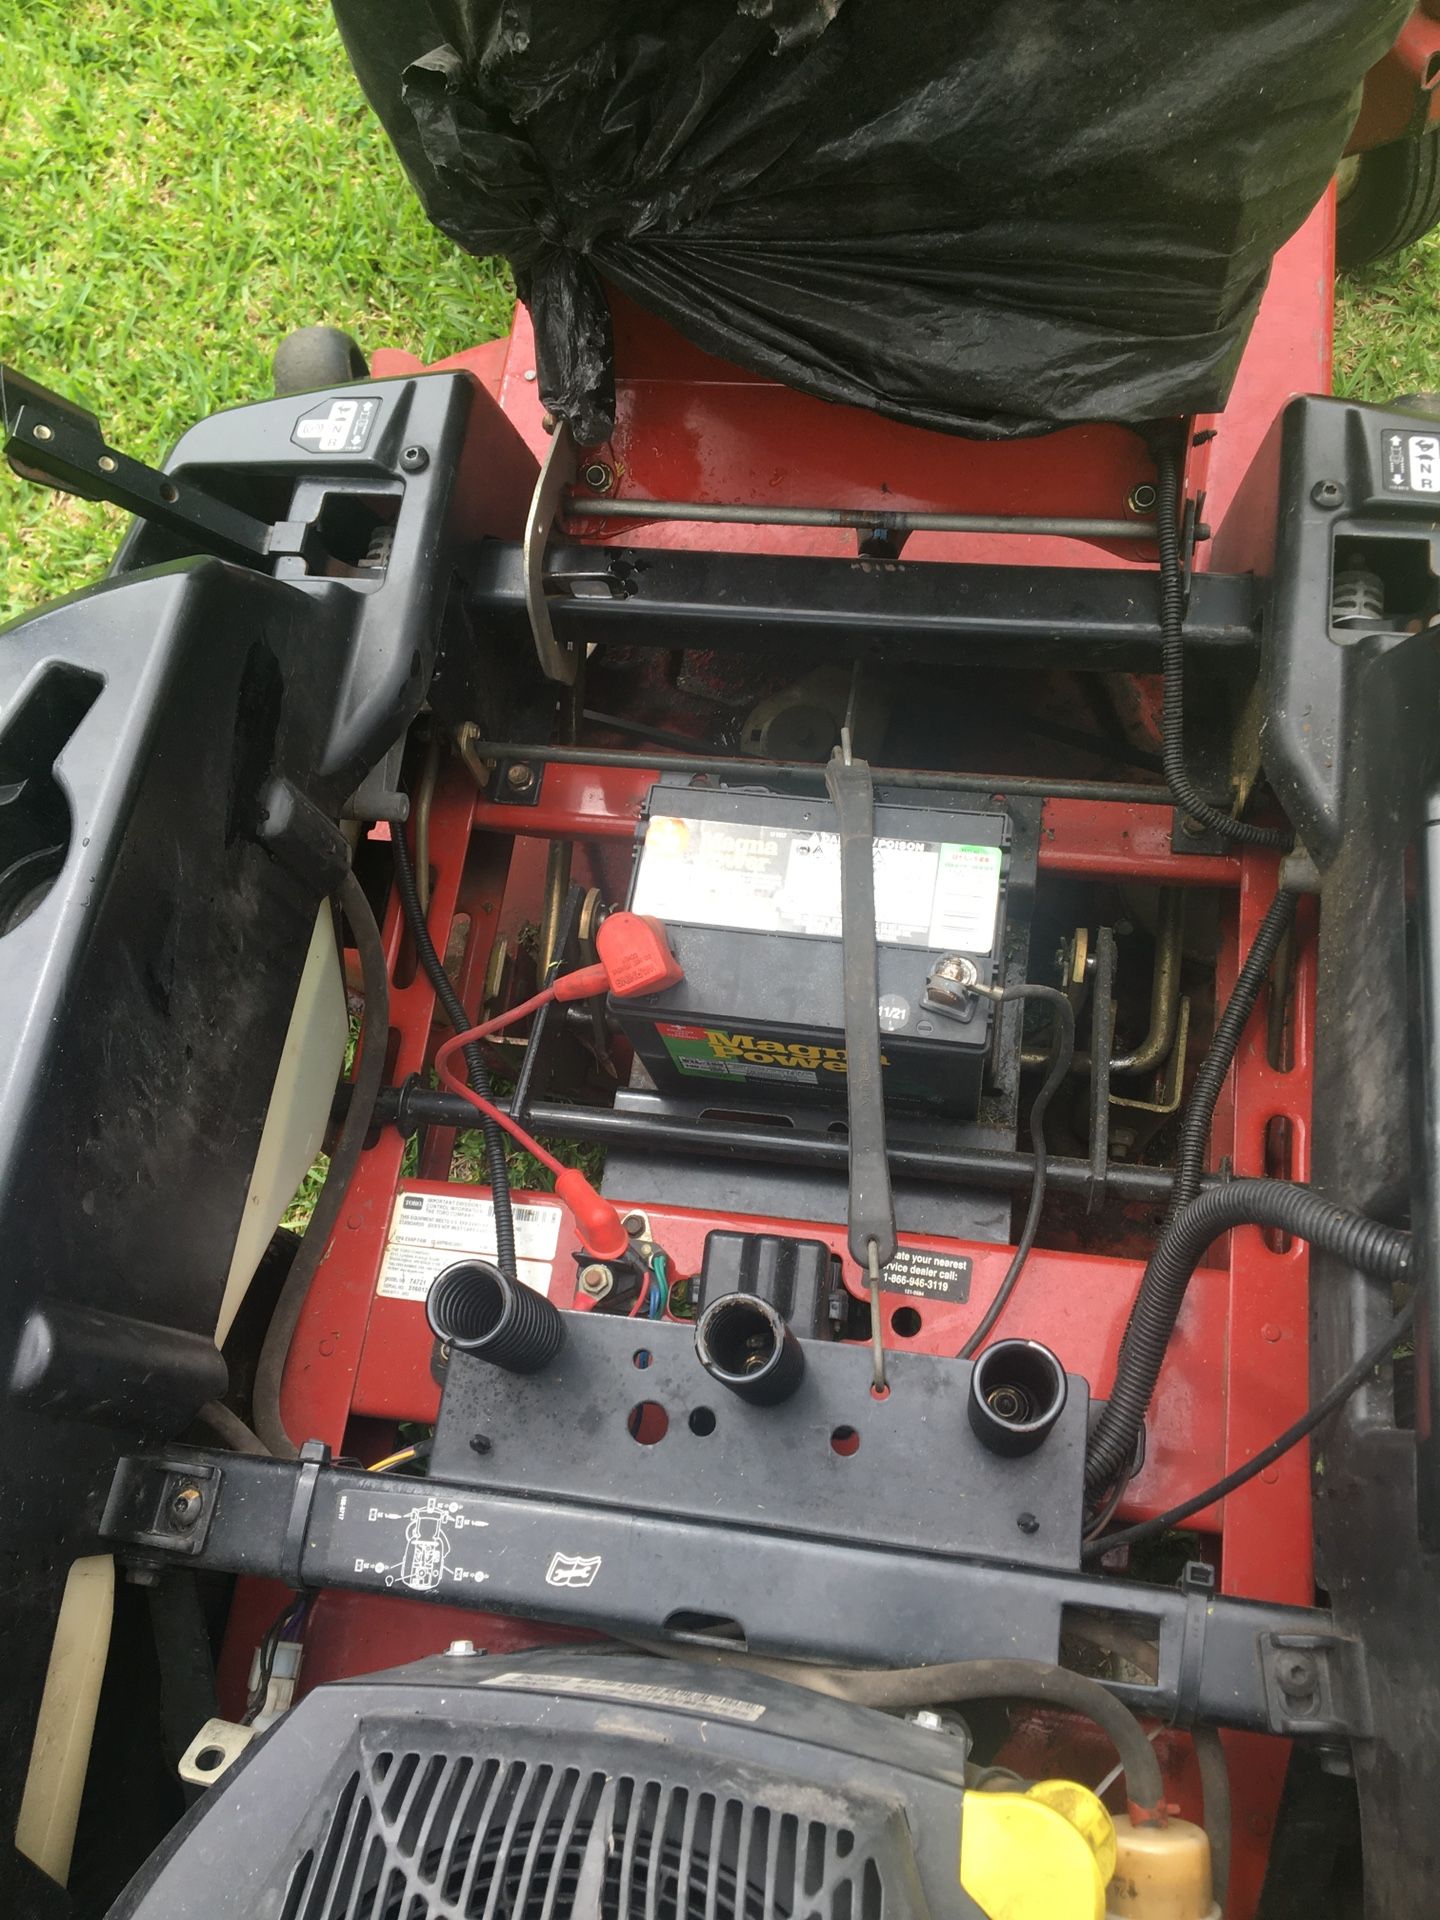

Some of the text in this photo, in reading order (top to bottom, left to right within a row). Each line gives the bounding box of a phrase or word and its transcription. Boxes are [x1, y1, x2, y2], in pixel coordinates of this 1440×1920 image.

[1420, 463, 1432, 473] N
[1421, 478, 1432, 488] R
[879, 1006, 906, 1020] 11/21
[709, 1044, 848, 1073] Powe
[895, 1252, 967, 1270] ate your nearest
[883, 1263, 958, 1281] rvice dealer call:
[883, 1273, 948, 1292] 1-866-946-3119
